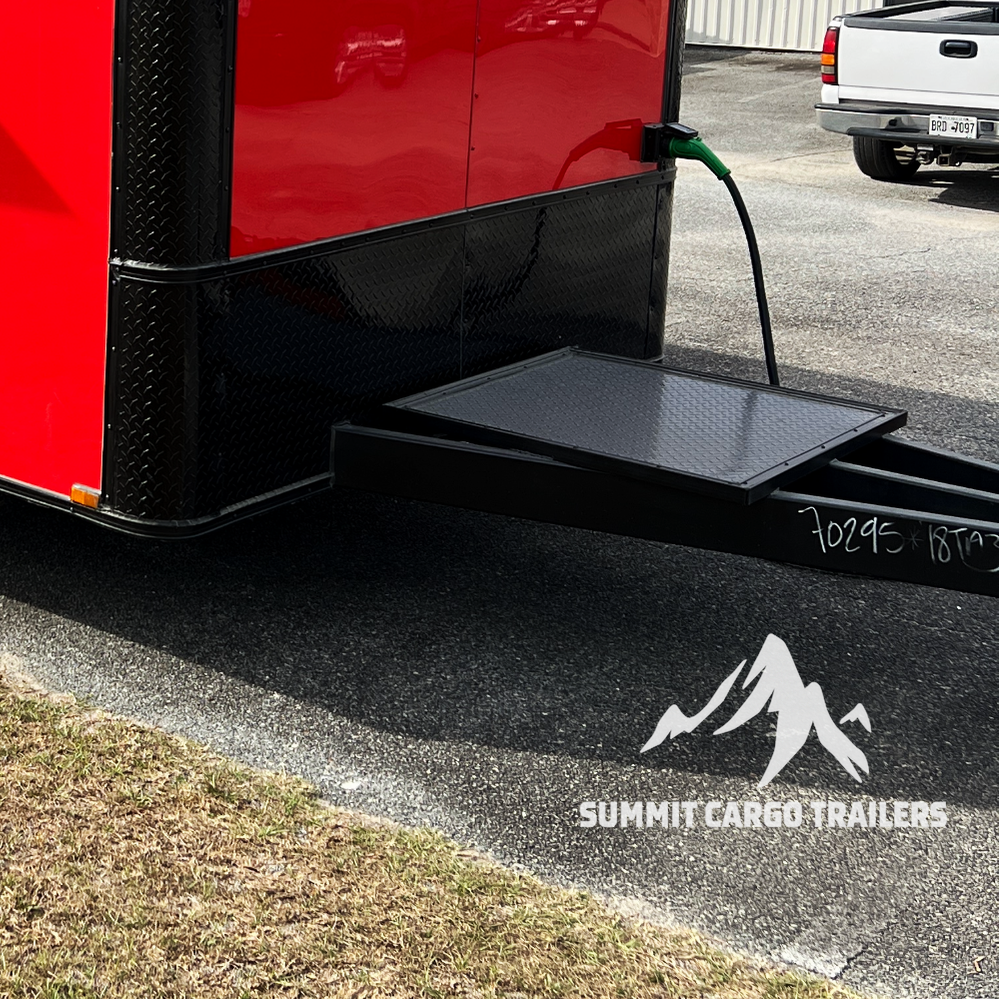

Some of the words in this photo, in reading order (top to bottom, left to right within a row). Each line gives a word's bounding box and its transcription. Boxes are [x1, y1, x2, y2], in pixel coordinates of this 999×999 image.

[932, 120, 947, 132] BRD
[954, 121, 975, 133] 7097
[797, 506, 905, 554] 70295
